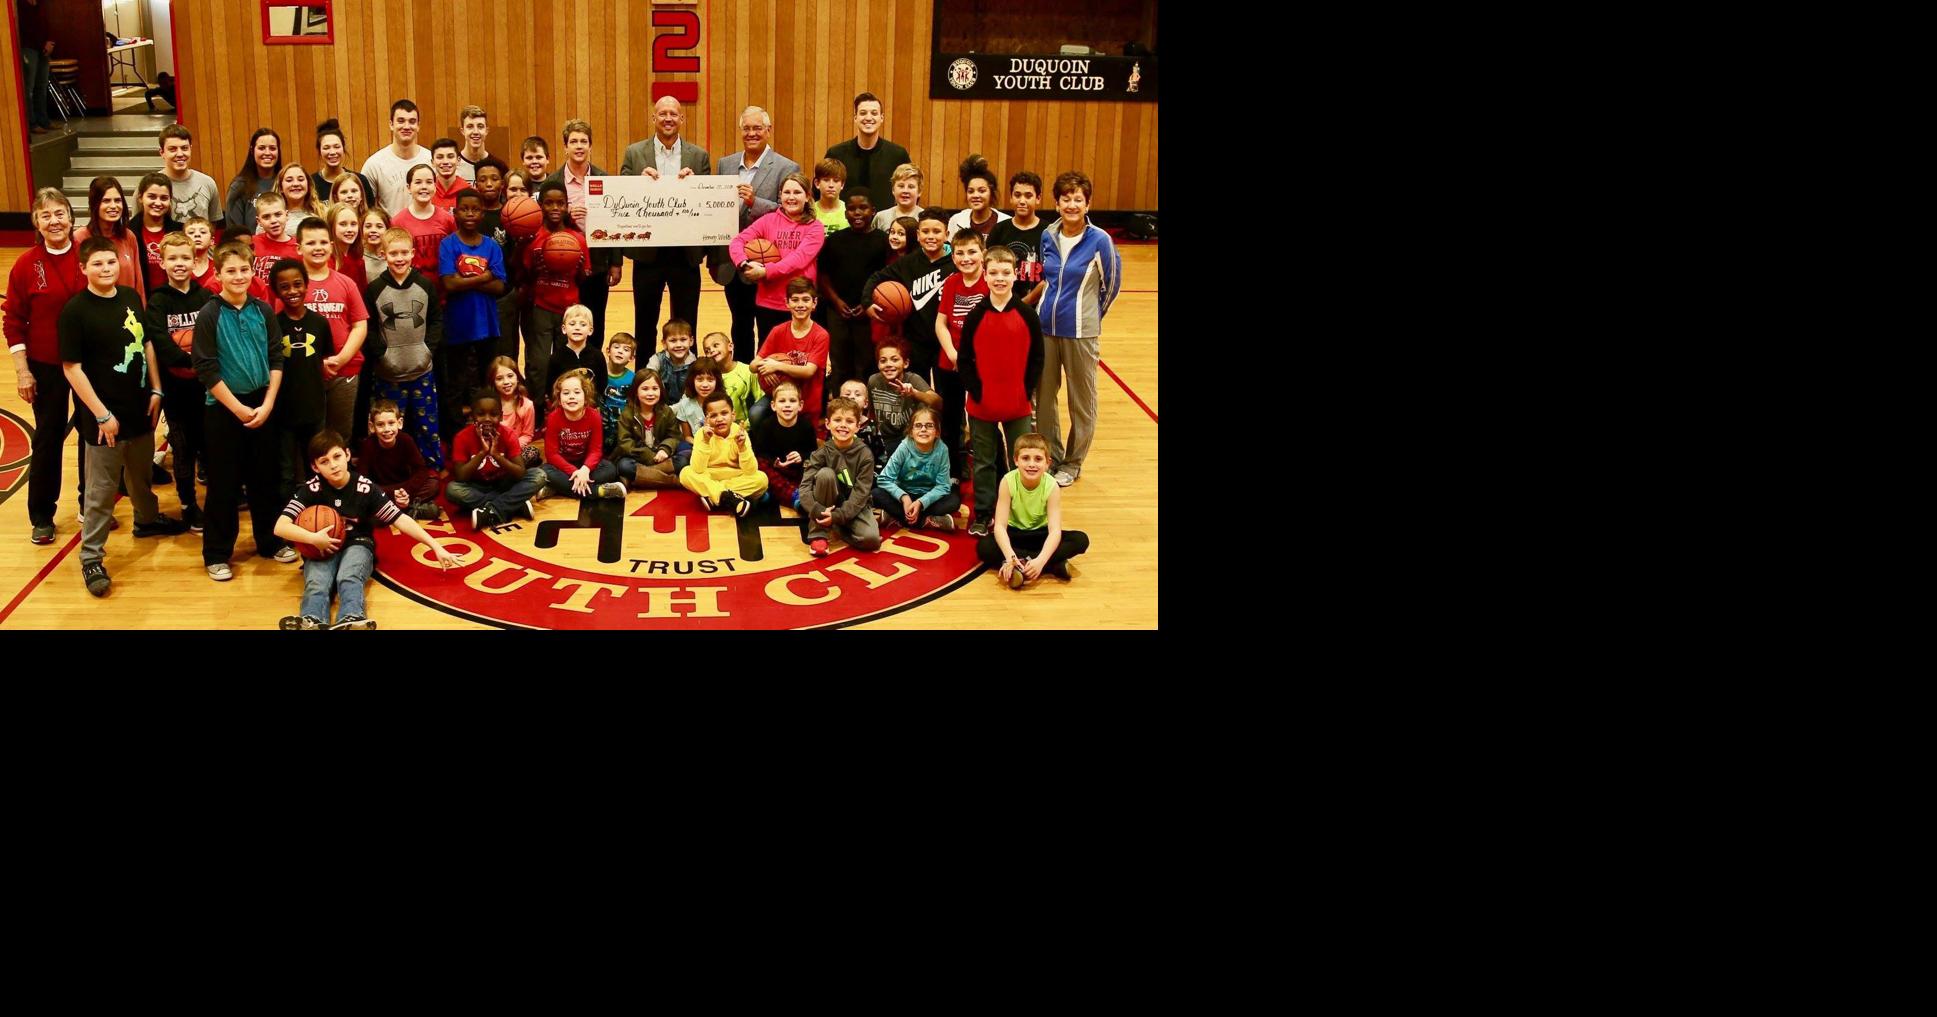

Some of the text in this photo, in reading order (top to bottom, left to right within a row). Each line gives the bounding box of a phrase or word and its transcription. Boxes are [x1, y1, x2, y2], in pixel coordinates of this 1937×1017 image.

[1010, 58, 1090, 75] DUQUOIN
[993, 75, 1105, 90] YOUTH CLUB
[643, 196, 665, 210] Youth
[668, 197, 687, 208] Club
[705, 201, 735, 209] 5,000.00
[611, 208, 630, 218] Five
[636, 207, 674, 218] Thousand
[912, 268, 941, 296] NIKE
[357, 475, 373, 494] 55
[389, 503, 970, 619] YOUTH CLU
[629, 558, 736, 575] TRUST
